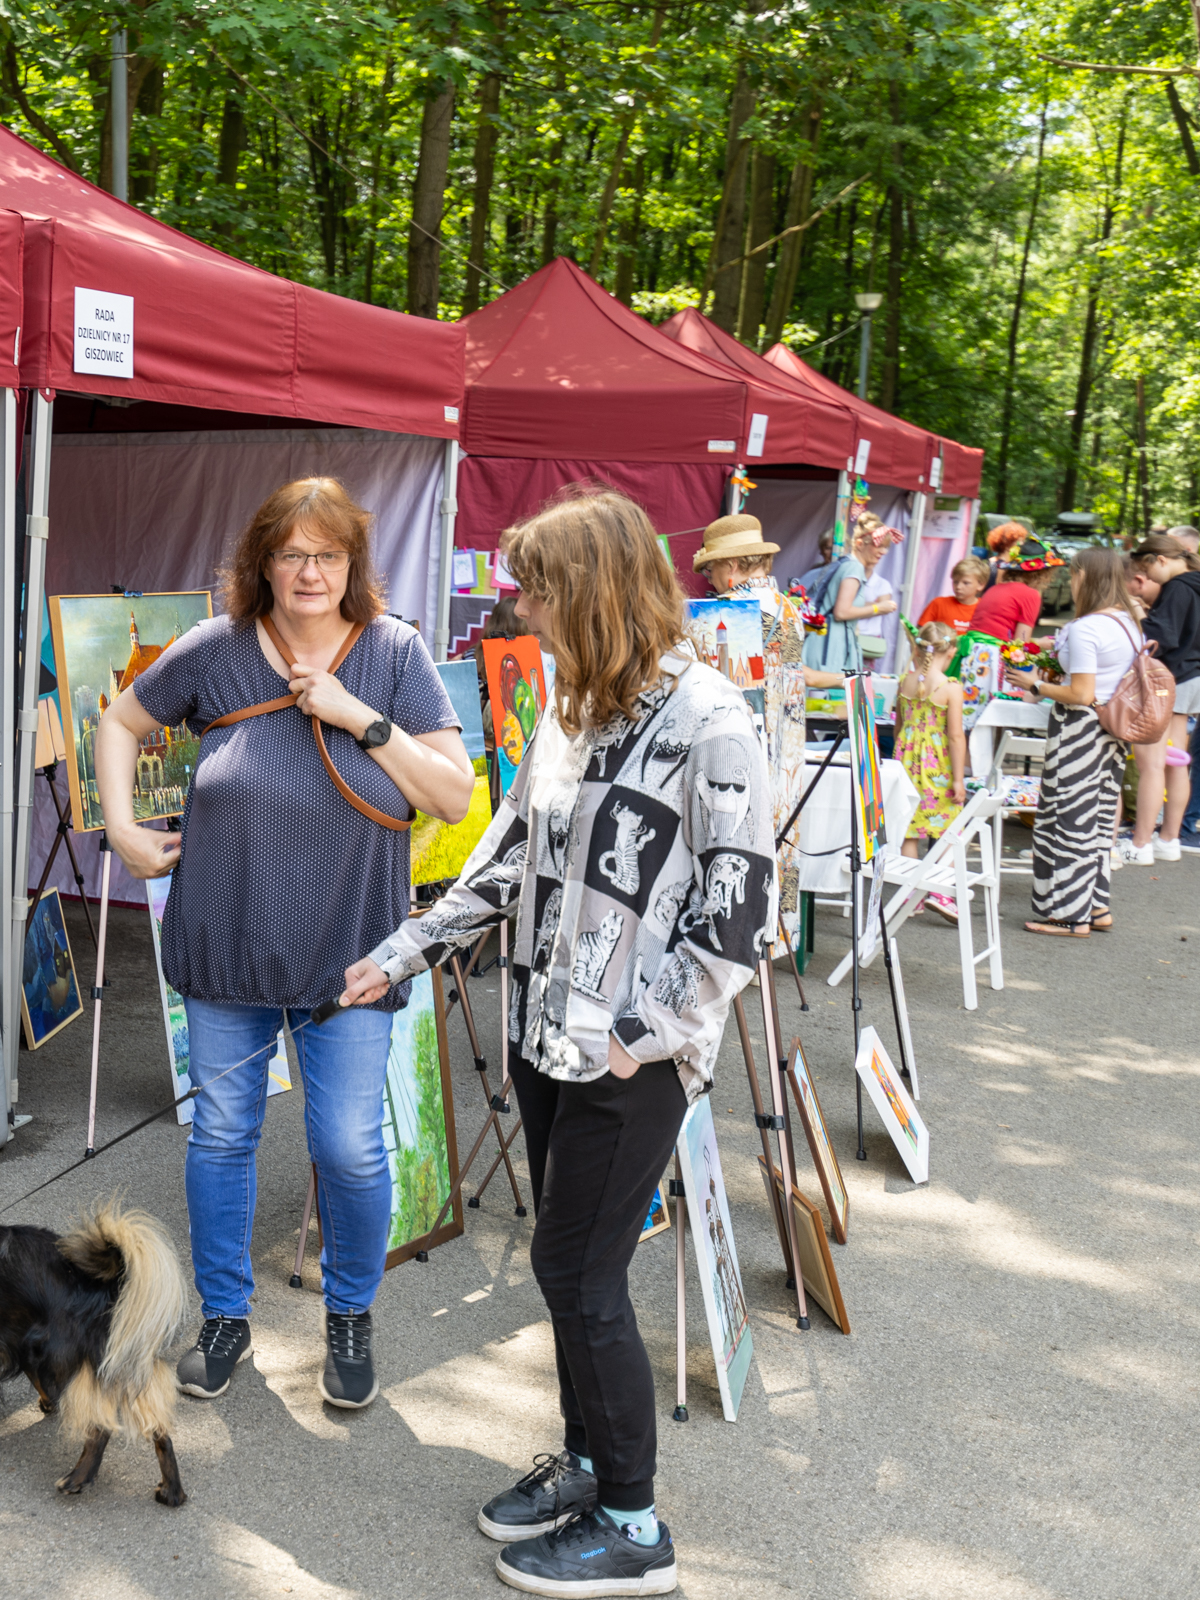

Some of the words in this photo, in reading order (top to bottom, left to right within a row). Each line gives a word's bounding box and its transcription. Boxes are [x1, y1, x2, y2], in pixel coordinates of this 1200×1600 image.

[95, 309, 115, 322] RADA
[78, 327, 111, 341] DZIELNICY
[112, 332, 121, 343] NR
[123, 334, 130, 344] 17
[85, 348, 123, 363] GISZOWIEC
[580, 1546, 606, 1559] Reebok
